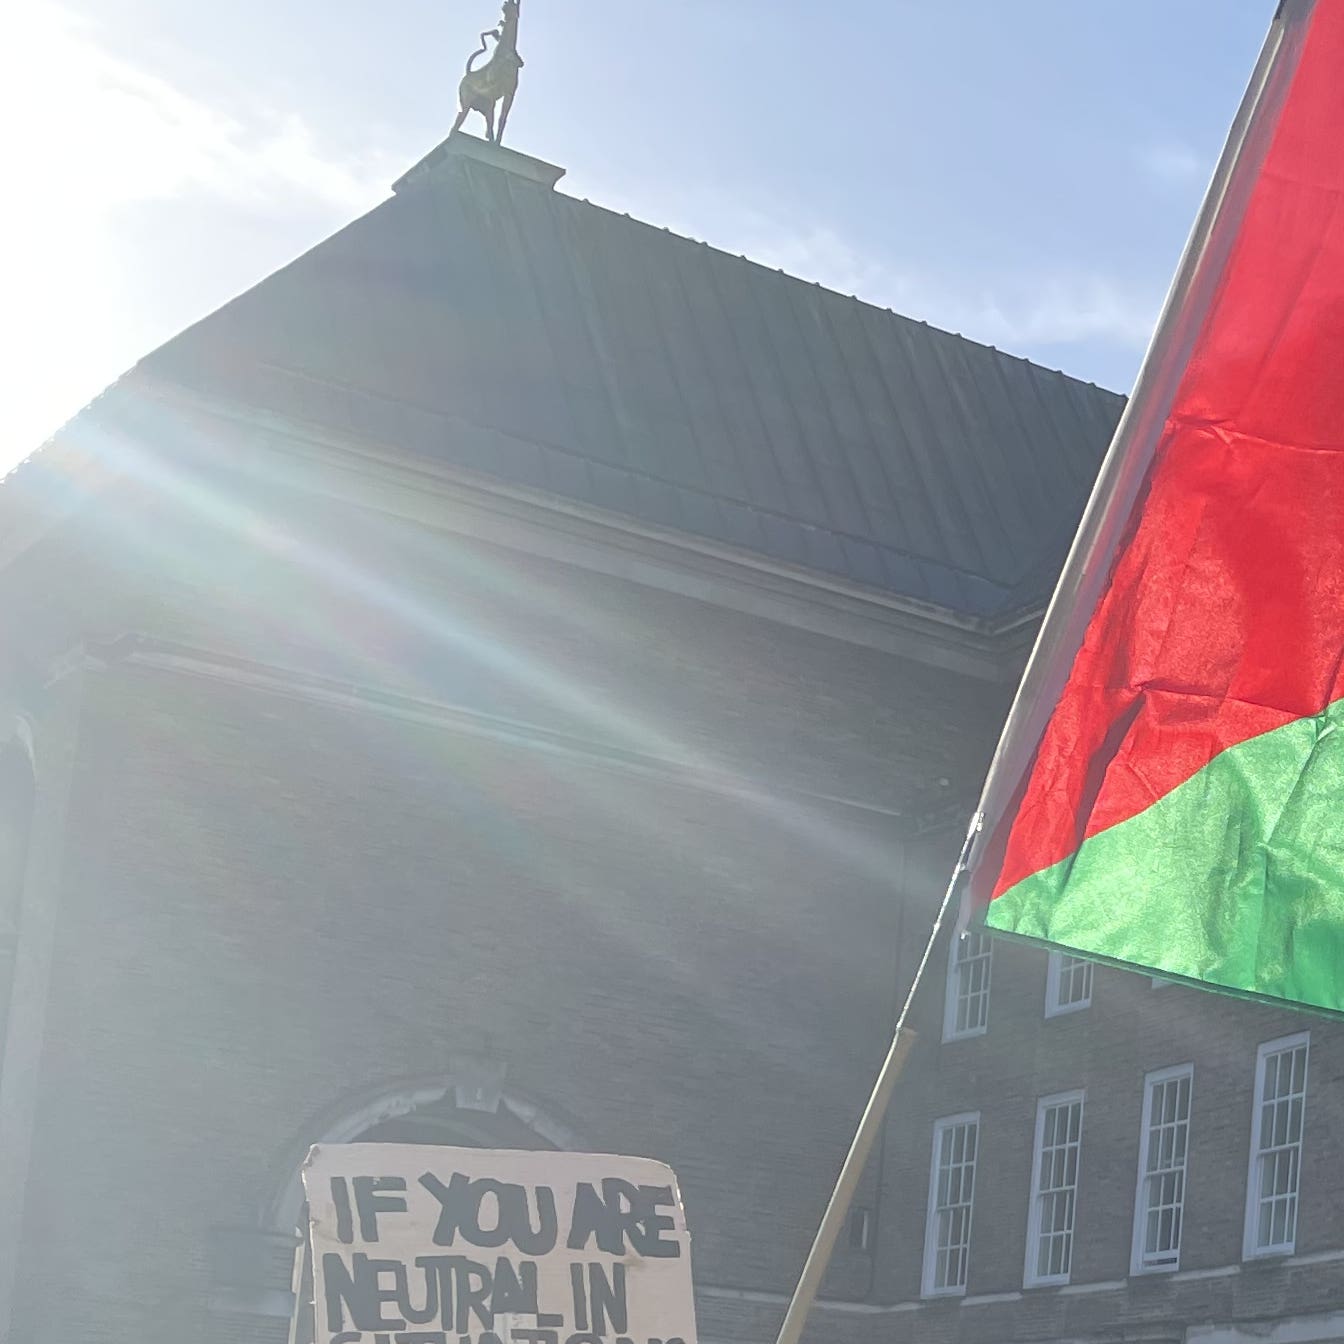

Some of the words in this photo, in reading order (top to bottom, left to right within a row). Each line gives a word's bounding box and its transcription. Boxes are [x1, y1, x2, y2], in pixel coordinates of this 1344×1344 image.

[330, 1176, 408, 1244] IF
[417, 1171, 559, 1256] YOU
[566, 1177, 681, 1258] ARE
[322, 1252, 564, 1334] NEUTRAL
[570, 1262, 628, 1336] IN
